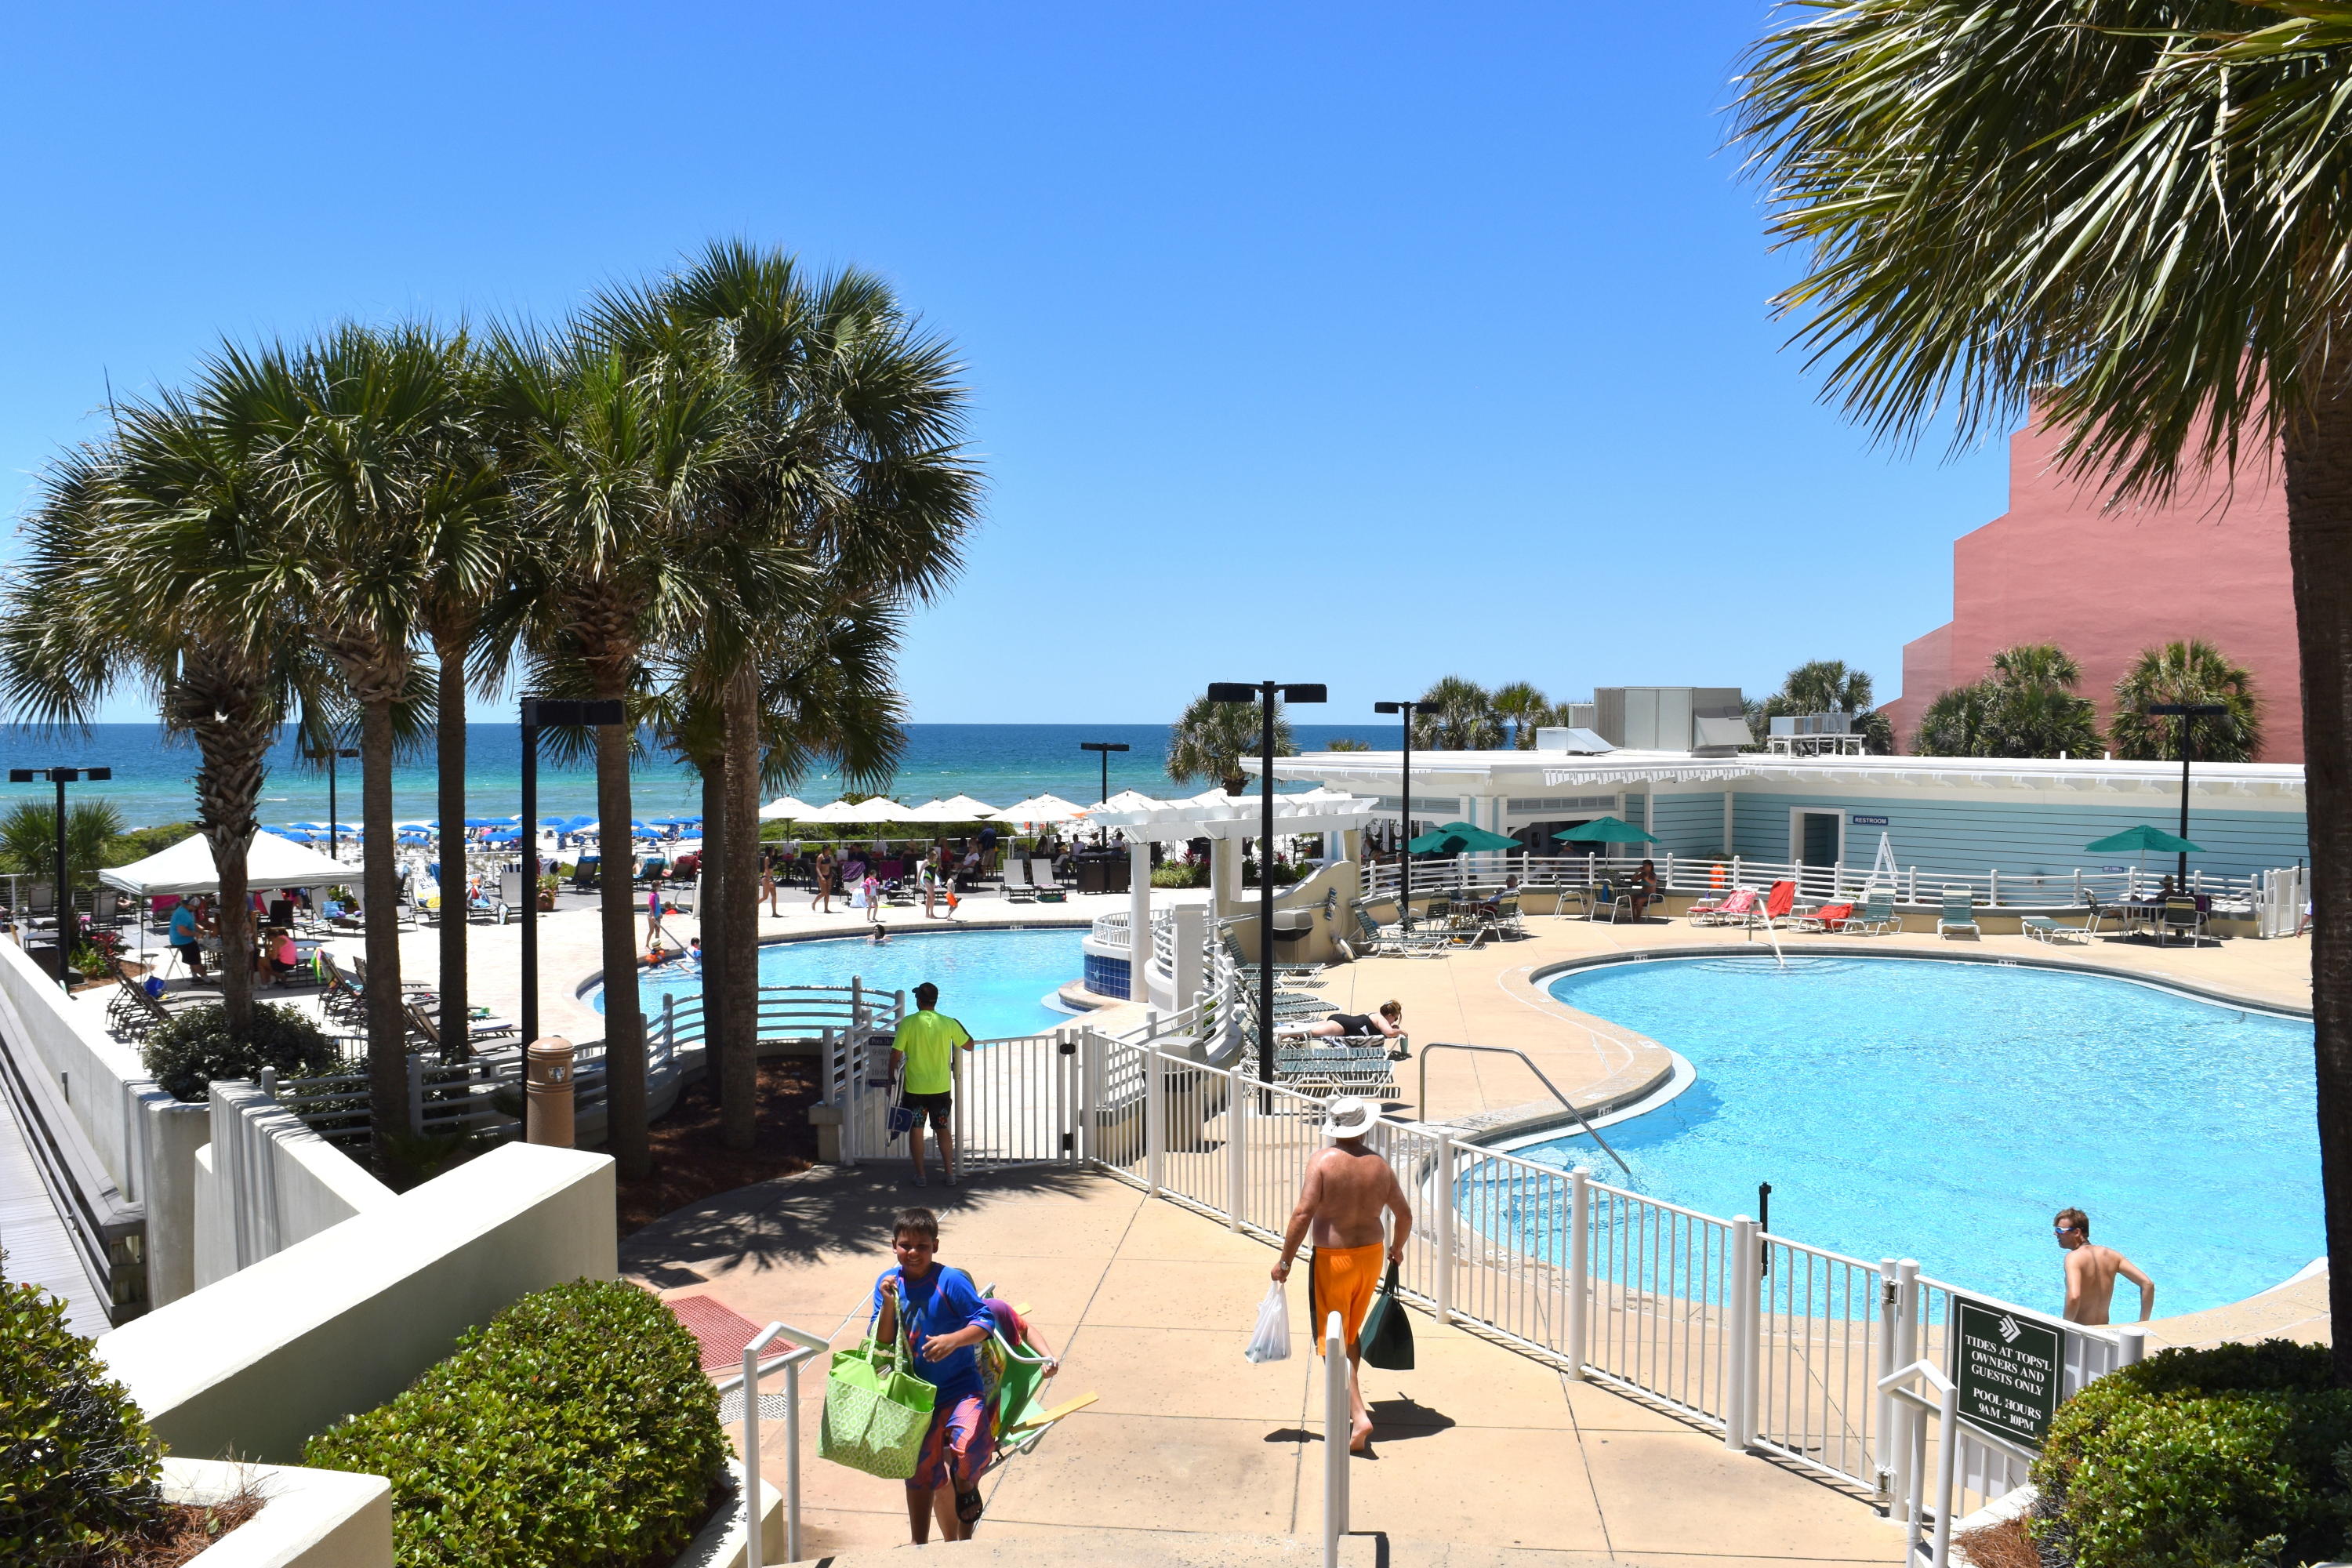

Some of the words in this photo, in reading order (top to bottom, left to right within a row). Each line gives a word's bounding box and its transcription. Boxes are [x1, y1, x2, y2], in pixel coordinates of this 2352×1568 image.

[1965, 1334, 1997, 1353] TIDES
[1998, 1346, 2013, 1359] AT
[2015, 1350, 2053, 1372] TOPS'L
[1971, 1350, 2018, 1374] OWNERS
[2020, 1367, 2045, 1382] AND
[1971, 1363, 2013, 1385] GUESTS
[2014, 1378, 2044, 1396] ONLY
[1973, 1387, 2002, 1406] POOL
[2004, 1398, 2042, 1420] HOURS
[1978, 1403, 2000, 1418] 9AM
[2009, 1414, 2034, 1432] 10PM
